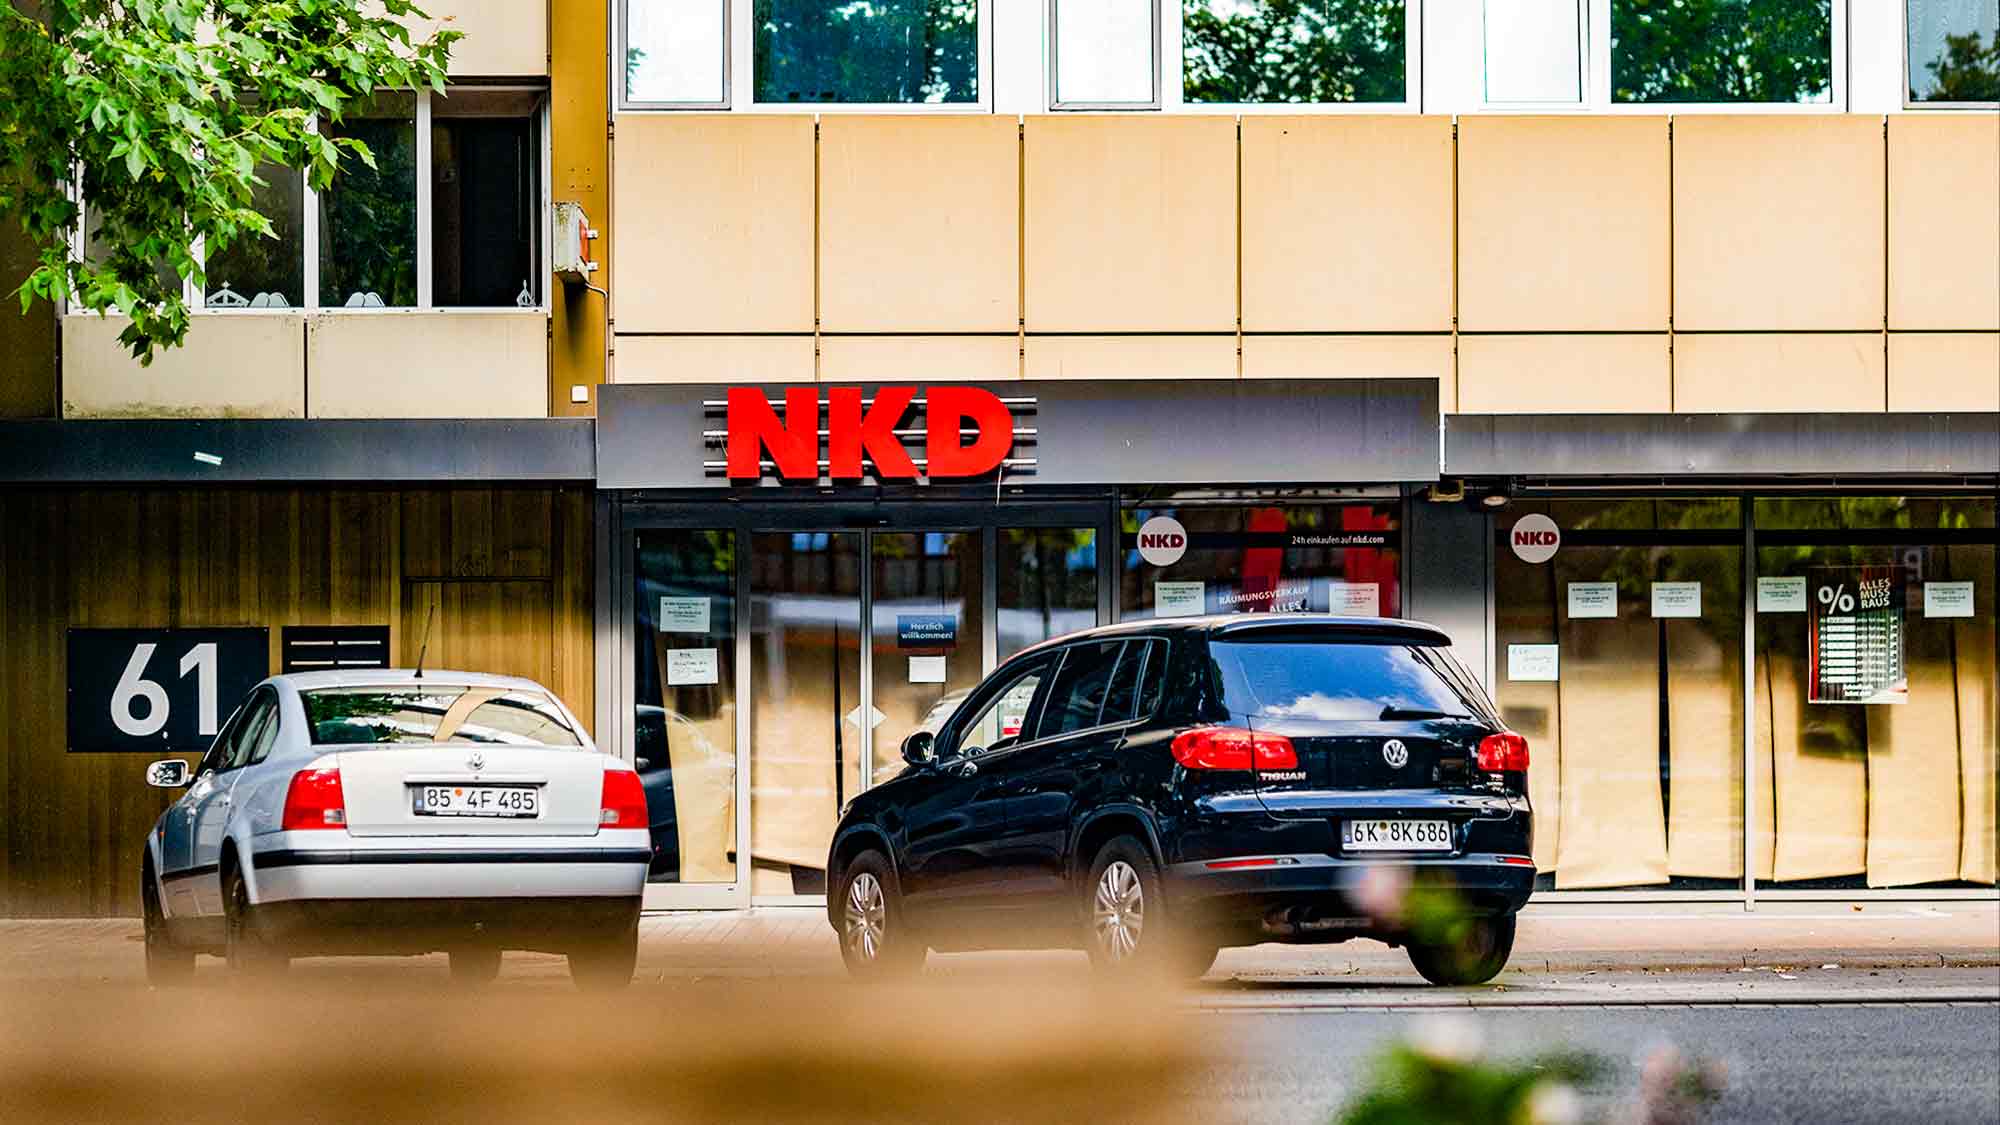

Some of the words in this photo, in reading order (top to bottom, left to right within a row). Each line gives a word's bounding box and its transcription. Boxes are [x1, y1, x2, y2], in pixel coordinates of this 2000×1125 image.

[727, 386, 1014, 479] NKD
[1141, 533, 1184, 548] NKD
[1292, 535, 1306, 545] 24h
[1307, 535, 1340, 545] einkaufen
[1340, 534, 1352, 545] auf
[1352, 534, 1385, 544] nkd.com
[1514, 531, 1557, 546] NKD
[1859, 578, 1891, 592] ALLES
[1859, 588, 1891, 600] MUSS
[1269, 600, 1301, 613] ALLES
[1861, 597, 1891, 609] RAUS
[911, 623, 944, 631] Herzlich
[110, 643, 217, 736] 61
[1260, 771, 1307, 781] TIGUAN
[427, 789, 451, 808] 85
[1354, 822, 1379, 842] 6K
